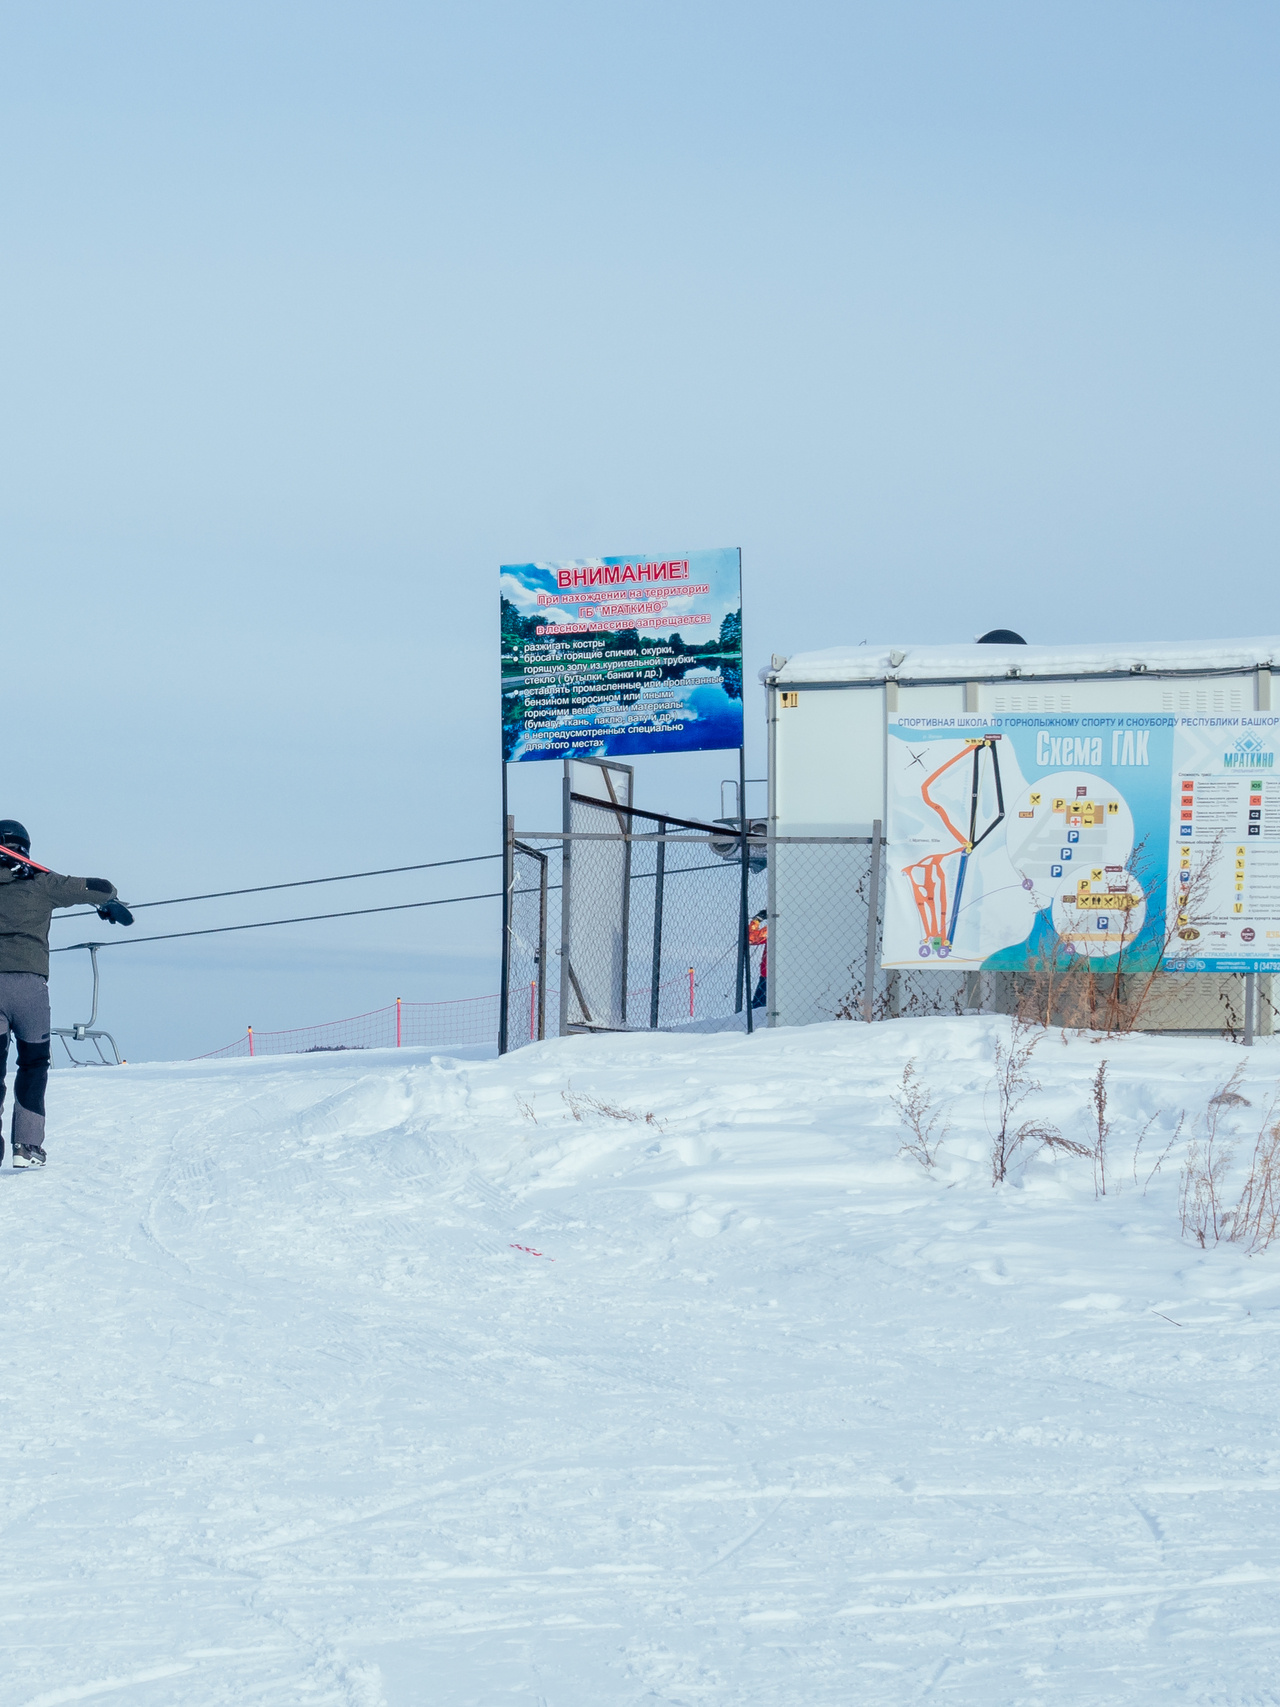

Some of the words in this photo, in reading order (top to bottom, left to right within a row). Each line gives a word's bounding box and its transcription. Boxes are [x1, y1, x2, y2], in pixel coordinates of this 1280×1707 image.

[558, 560, 689, 588] ВНИМАНИЕ!
[537, 594, 559, 606] При
[561, 590, 627, 605] нахождении
[629, 588, 643, 599] на
[644, 584, 709, 598] территории
[536, 626, 545, 635] в
[546, 622, 587, 634] лесном
[589, 619, 634, 632] массиве
[636, 614, 711, 629] запрещается:
[524, 644, 570, 654] разжигать
[572, 640, 606, 648] костры
[524, 653, 561, 664] бросать
[564, 650, 603, 661] горящие
[604, 649, 639, 658] спички,
[640, 646, 675, 656] окурки,
[524, 664, 565, 674] горящую
[567, 662, 588, 672] золу
[602, 656, 661, 670] курительной
[663, 655, 697, 666] трубки,
[524, 676, 556, 685] стекло
[564, 673, 605, 683] бутылки,
[606, 671, 634, 680] банки
[636, 670, 642, 678] и
[644, 668, 663, 678] др.)
[524, 686, 570, 697] оставлять
[572, 681, 642, 694] промасленные
[643, 680, 662, 688] или
[662, 676, 725, 688] пропитанные
[524, 697, 570, 707] бензином
[572, 694, 620, 705] керосином
[623, 692, 641, 700] или
[643, 691, 674, 699] иными
[524, 709, 570, 719] горючими
[572, 705, 628, 716] веществами
[631, 702, 684, 712] материалы
[524, 720, 561, 730] (бумагу,
[594, 716, 626, 725] паклю,
[628, 714, 650, 724] вату
[659, 710, 679, 722] др.)
[898, 718, 955, 727] СПОРТИВНАЯ
[958, 718, 988, 727] ШКОЛА
[990, 718, 1003, 727] ПО
[1005, 718, 1080, 727] ГОРНОЛЫЖНОМУ
[1081, 718, 1116, 727] СПОРТУ
[1118, 718, 1124, 726] И
[1126, 718, 1180, 728] СНОУБОРДУ
[1181, 718, 1240, 727] РЕСПУБЛИКИ
[1241, 718, 1280, 726] БАШКОР
[524, 732, 530, 740] в
[532, 727, 626, 740] непредусмотренных
[628, 723, 684, 734] специально
[525, 743, 544, 752] для
[545, 741, 570, 750] этого
[572, 739, 604, 748] местах
[1036, 730, 1102, 766] Схема
[1112, 730, 1150, 766] ГЛК
[1224, 752, 1274, 768] МРАТКИНО
